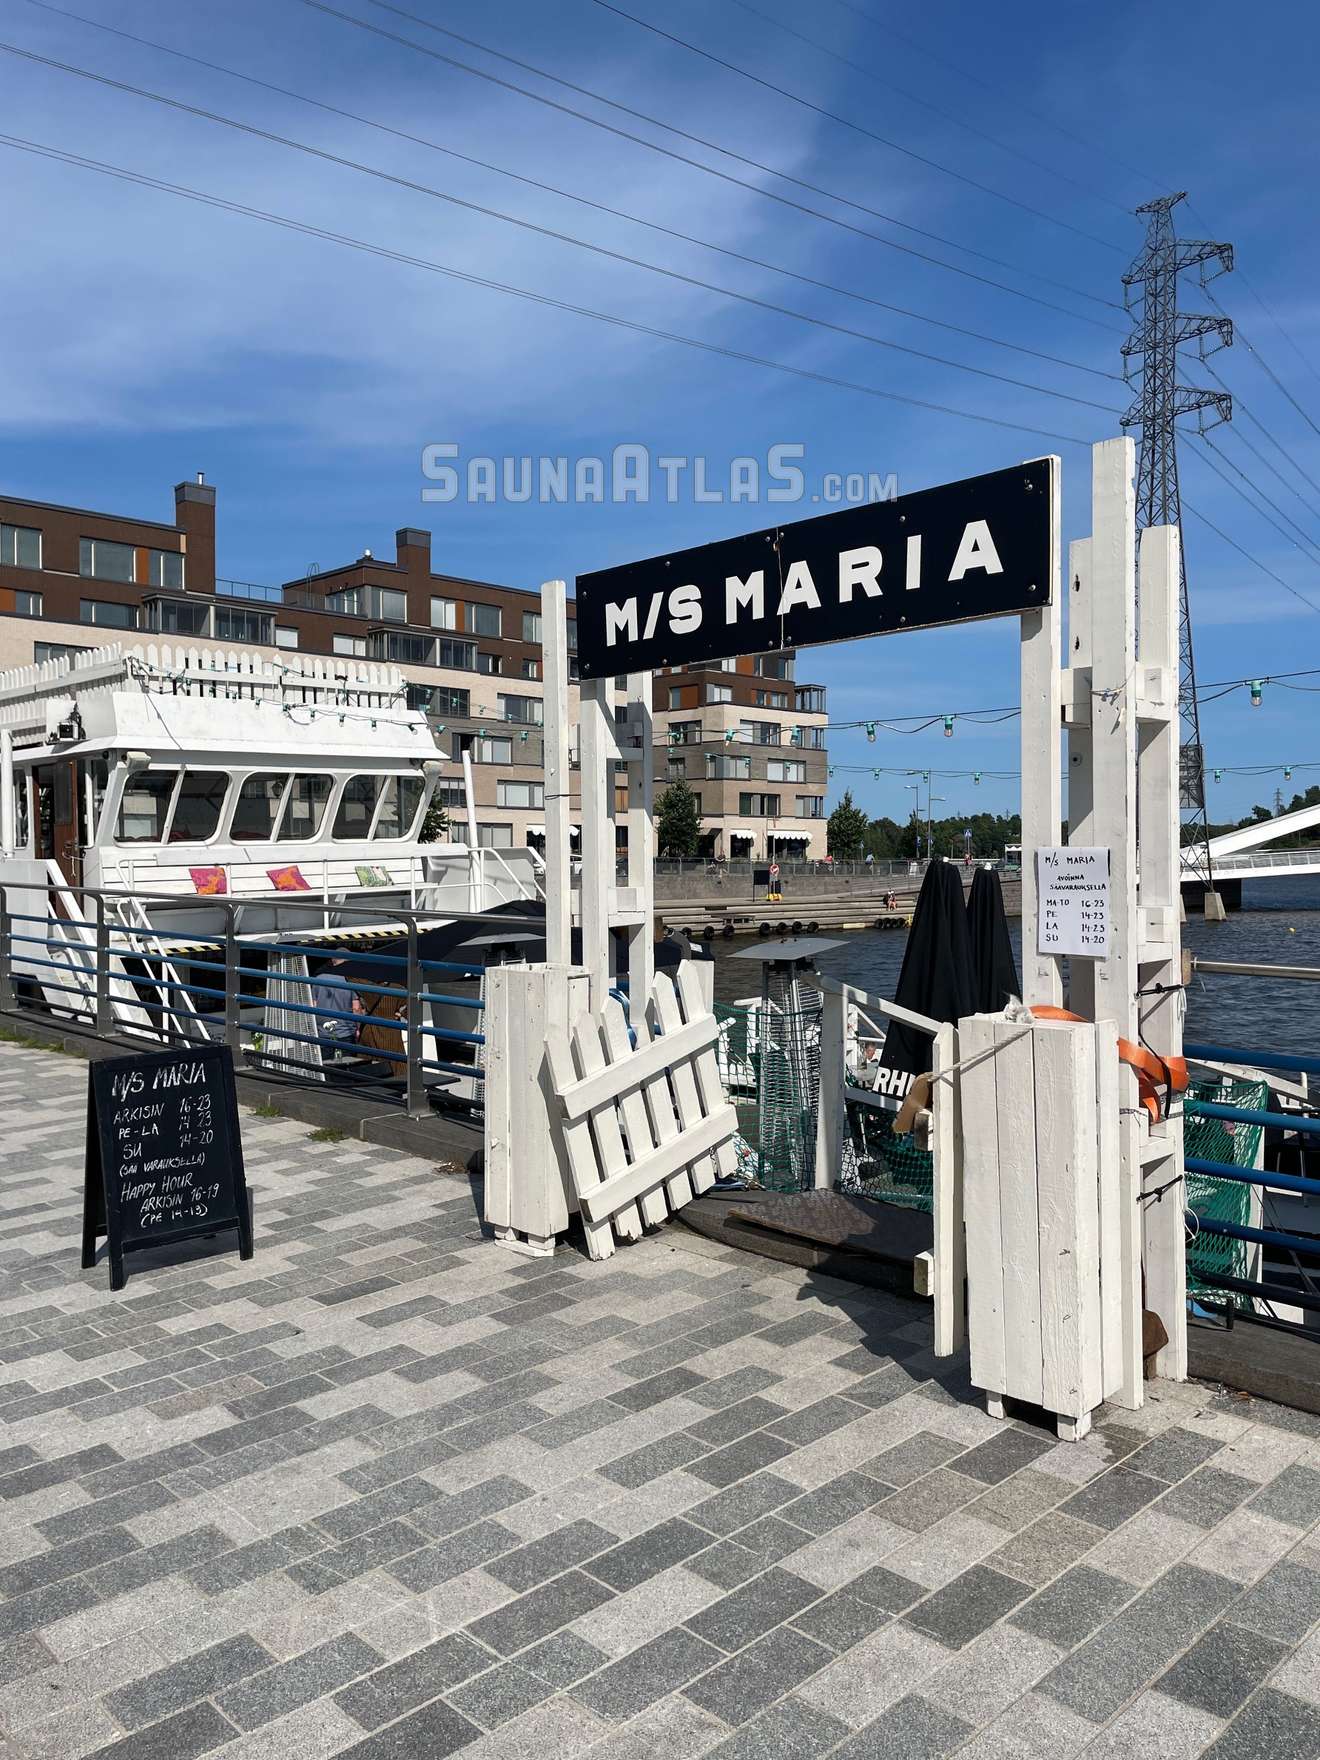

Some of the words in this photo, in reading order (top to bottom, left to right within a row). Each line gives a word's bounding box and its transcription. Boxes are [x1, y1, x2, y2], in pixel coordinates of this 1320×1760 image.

[604, 584, 703, 647] M/S
[724, 518, 1005, 625] MARIA
[1045, 852, 1059, 868] M/S
[1066, 856, 1096, 865] MARIA
[1046, 910, 1058, 918] PE
[1081, 911, 1104, 920] 14-23
[1081, 899, 1105, 908] 16-23
[1045, 922, 1059, 930] LA
[1045, 933, 1059, 942] SU
[1081, 935, 1105, 944] 14-20
[112, 1071, 145, 1102] M/S
[152, 1062, 206, 1090] MARIA
[113, 1102, 165, 1125] ARKISIN
[180, 1093, 211, 1114] 16-23
[123, 1142, 142, 1160] SU
[179, 1129, 214, 1148] 14-20
[120, 1181, 156, 1203] HAPPY
[161, 1172, 193, 1193] HOUR
[140, 1193, 184, 1213] ARKISIN
[191, 1183, 220, 1202] 16-19
